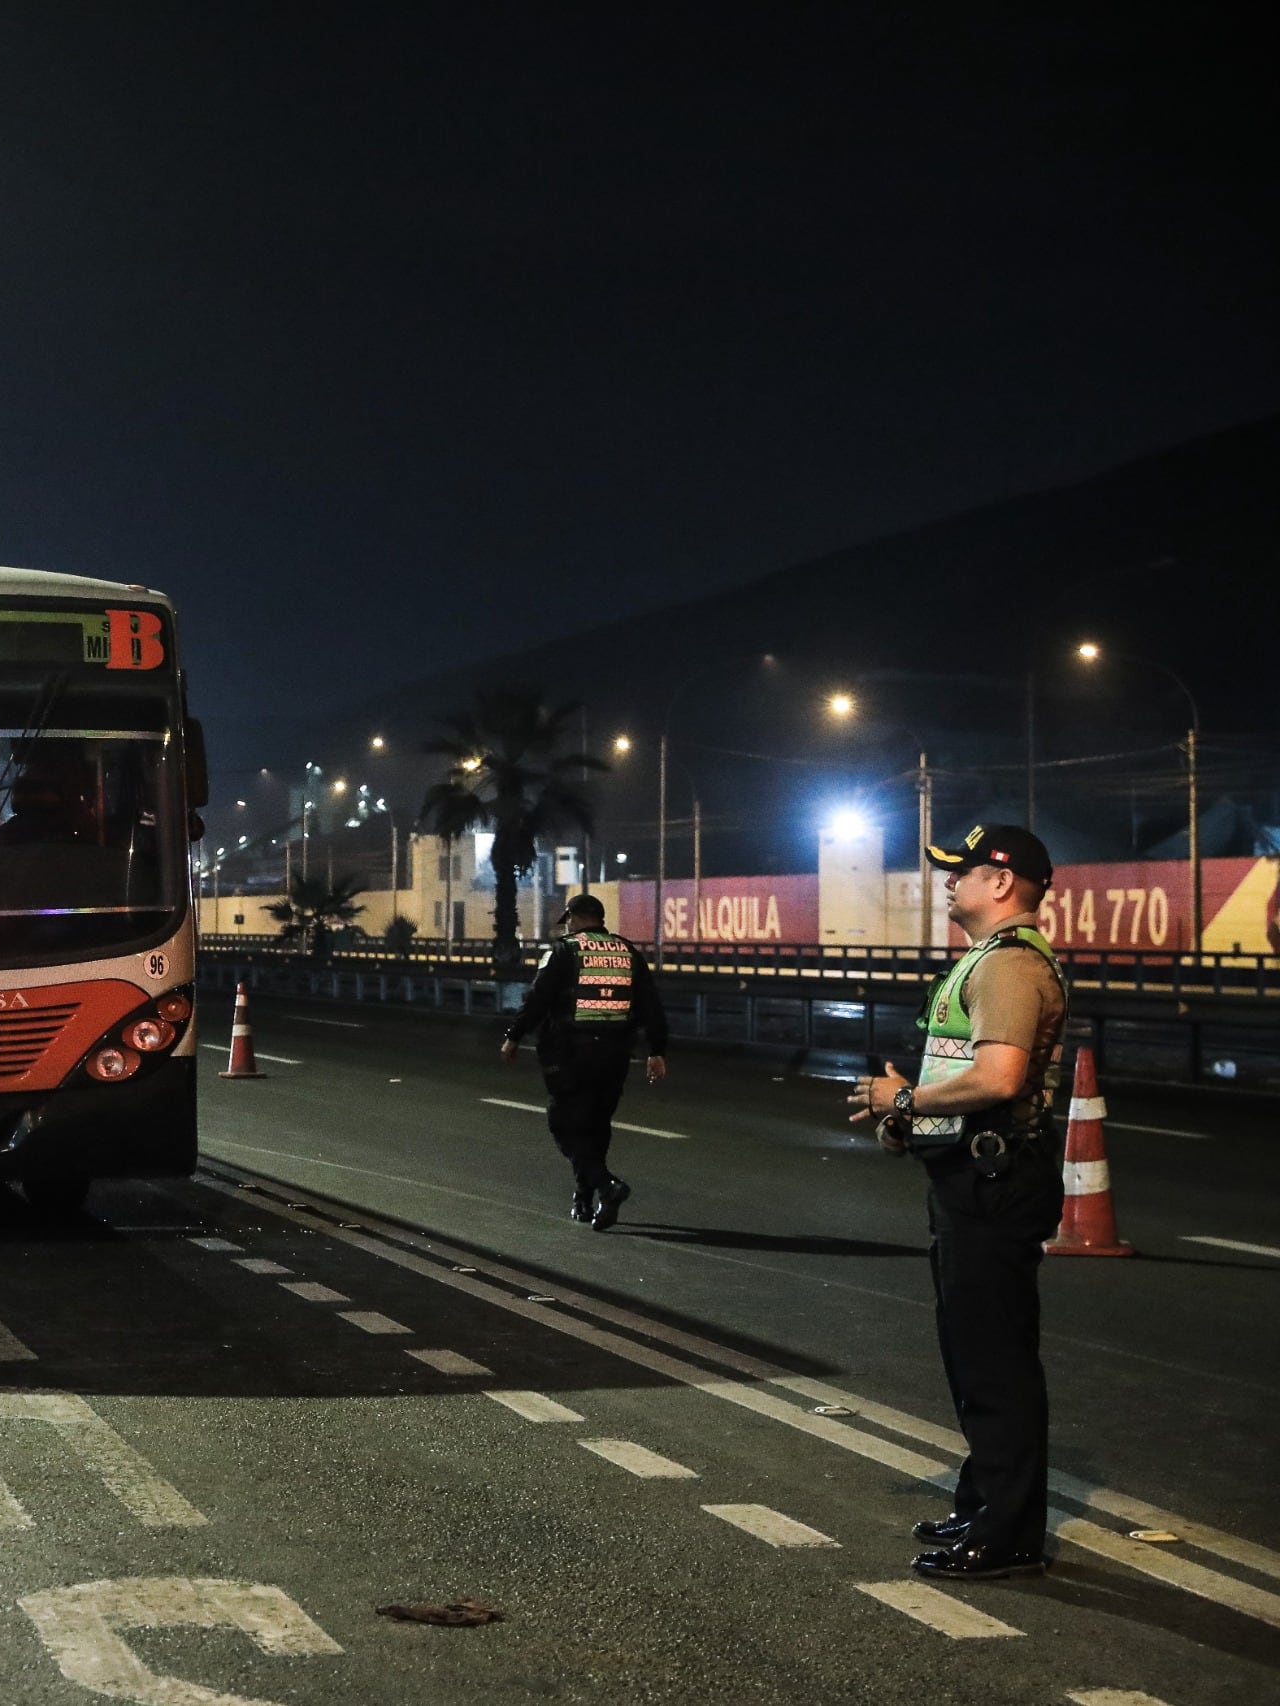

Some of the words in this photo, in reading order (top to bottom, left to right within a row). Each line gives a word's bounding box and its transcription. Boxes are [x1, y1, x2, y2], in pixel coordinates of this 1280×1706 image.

[105, 609, 165, 669] B
[663, 896, 688, 939] SE
[692, 894, 781, 942] ALQUILA
[1039, 888, 1096, 944] 514
[1106, 886, 1168, 946] 770
[580, 940, 628, 951] POLICIA
[583, 955, 631, 969] CARRETERAS
[150, 955, 164, 975] 96
